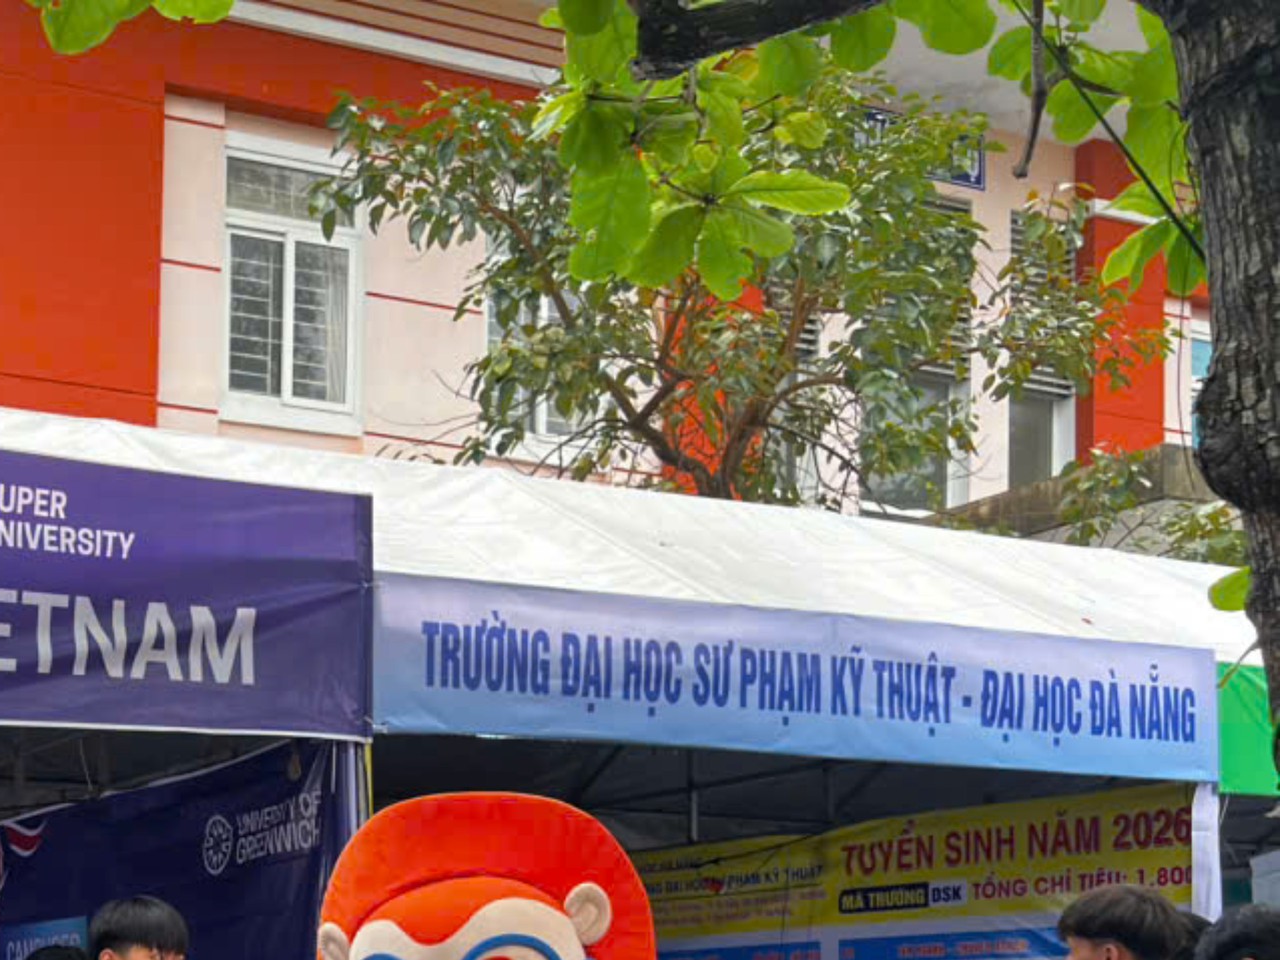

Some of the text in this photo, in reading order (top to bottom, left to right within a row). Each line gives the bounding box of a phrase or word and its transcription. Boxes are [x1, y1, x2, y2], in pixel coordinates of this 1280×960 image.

[421, 610, 1196, 746] TRƯỜNG ĐẠI HỌC SƯ PHẠM KỸ THUẬT ĐẠI HỌC ĐÀ NẴNG
[299, 790, 321, 817] OF
[236, 818, 321, 864] GREENWICH
[840, 806, 1192, 877] TUYỂN SINH NĂM 2026
[932, 885, 962, 903] DSK
[972, 871, 1028, 899] TỔNG
[1034, 868, 1073, 895] CHỈ
